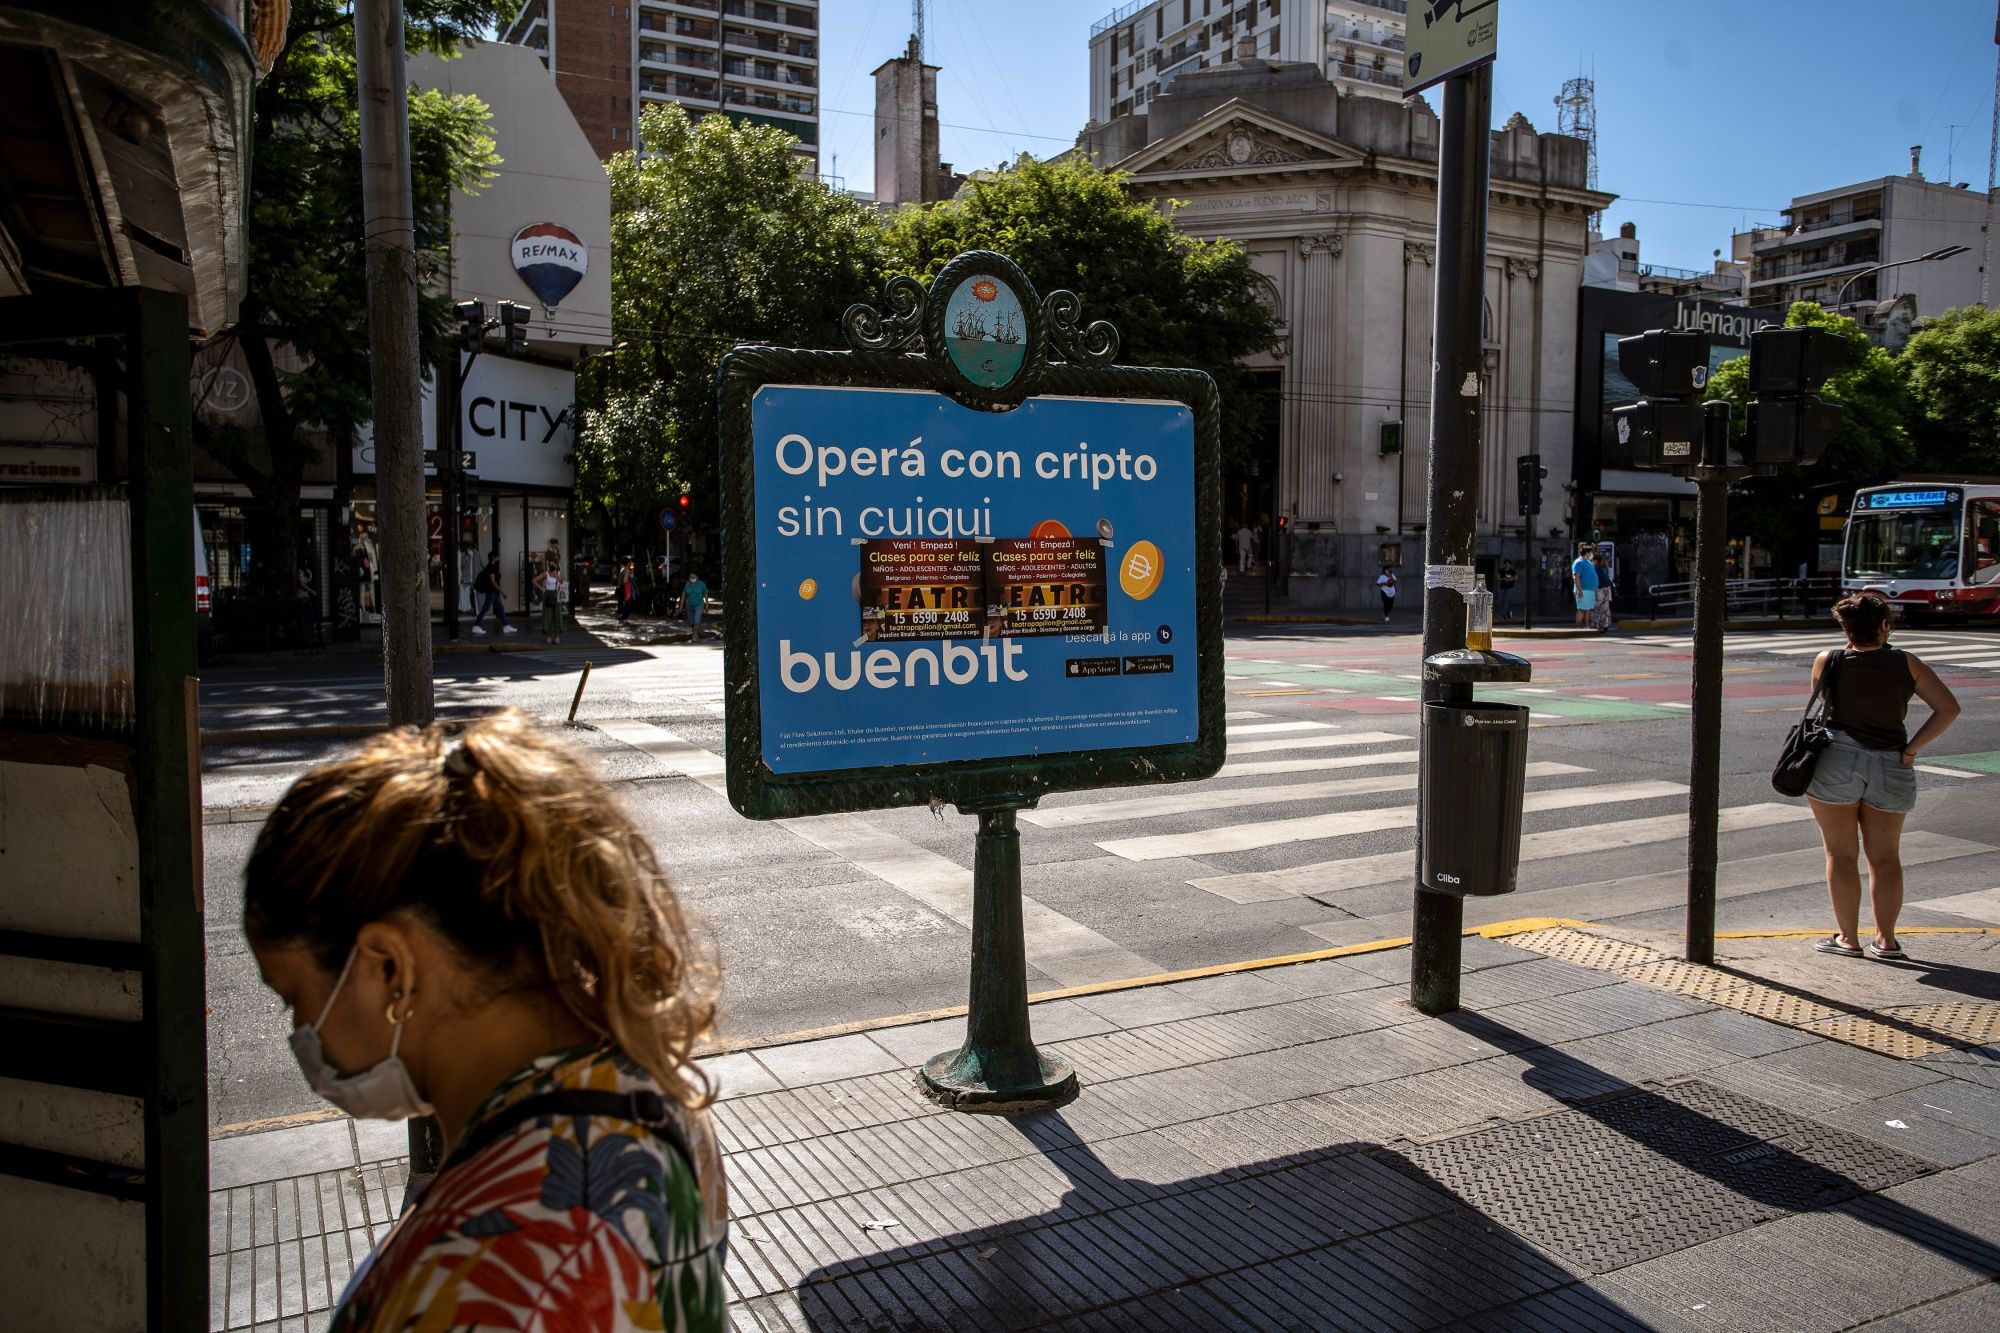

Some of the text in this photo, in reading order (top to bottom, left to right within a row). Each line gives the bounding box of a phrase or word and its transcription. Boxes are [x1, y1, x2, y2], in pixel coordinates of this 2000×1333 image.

[522, 244, 578, 262] RE/MAX
[468, 396, 569, 444] CITY
[775, 433, 1158, 490] Operá con cripto
[777, 495, 992, 538] sin cuiqui
[870, 552, 906, 562] Clases
[910, 554, 934, 564] para
[958, 552, 980, 561] felíz
[992, 550, 1096, 563] Clases para ser felíz
[871, 586, 985, 609] EATR
[996, 584, 1104, 608] EATR
[893, 611, 969, 624] 15 6590 2408
[1015, 607, 1086, 620] 15 6590 2408
[889, 623, 976, 632] teatropapillon@gmail.com
[1011, 619, 1092, 628] teatropapillon@gmail.com
[1120, 630, 1128, 640] la
[1132, 632, 1152, 643] app
[780, 638, 1029, 693] buenbit
[1082, 666, 1096, 675] App
[1138, 662, 1171, 671] Google Play
[1437, 872, 1460, 884] Cliba
